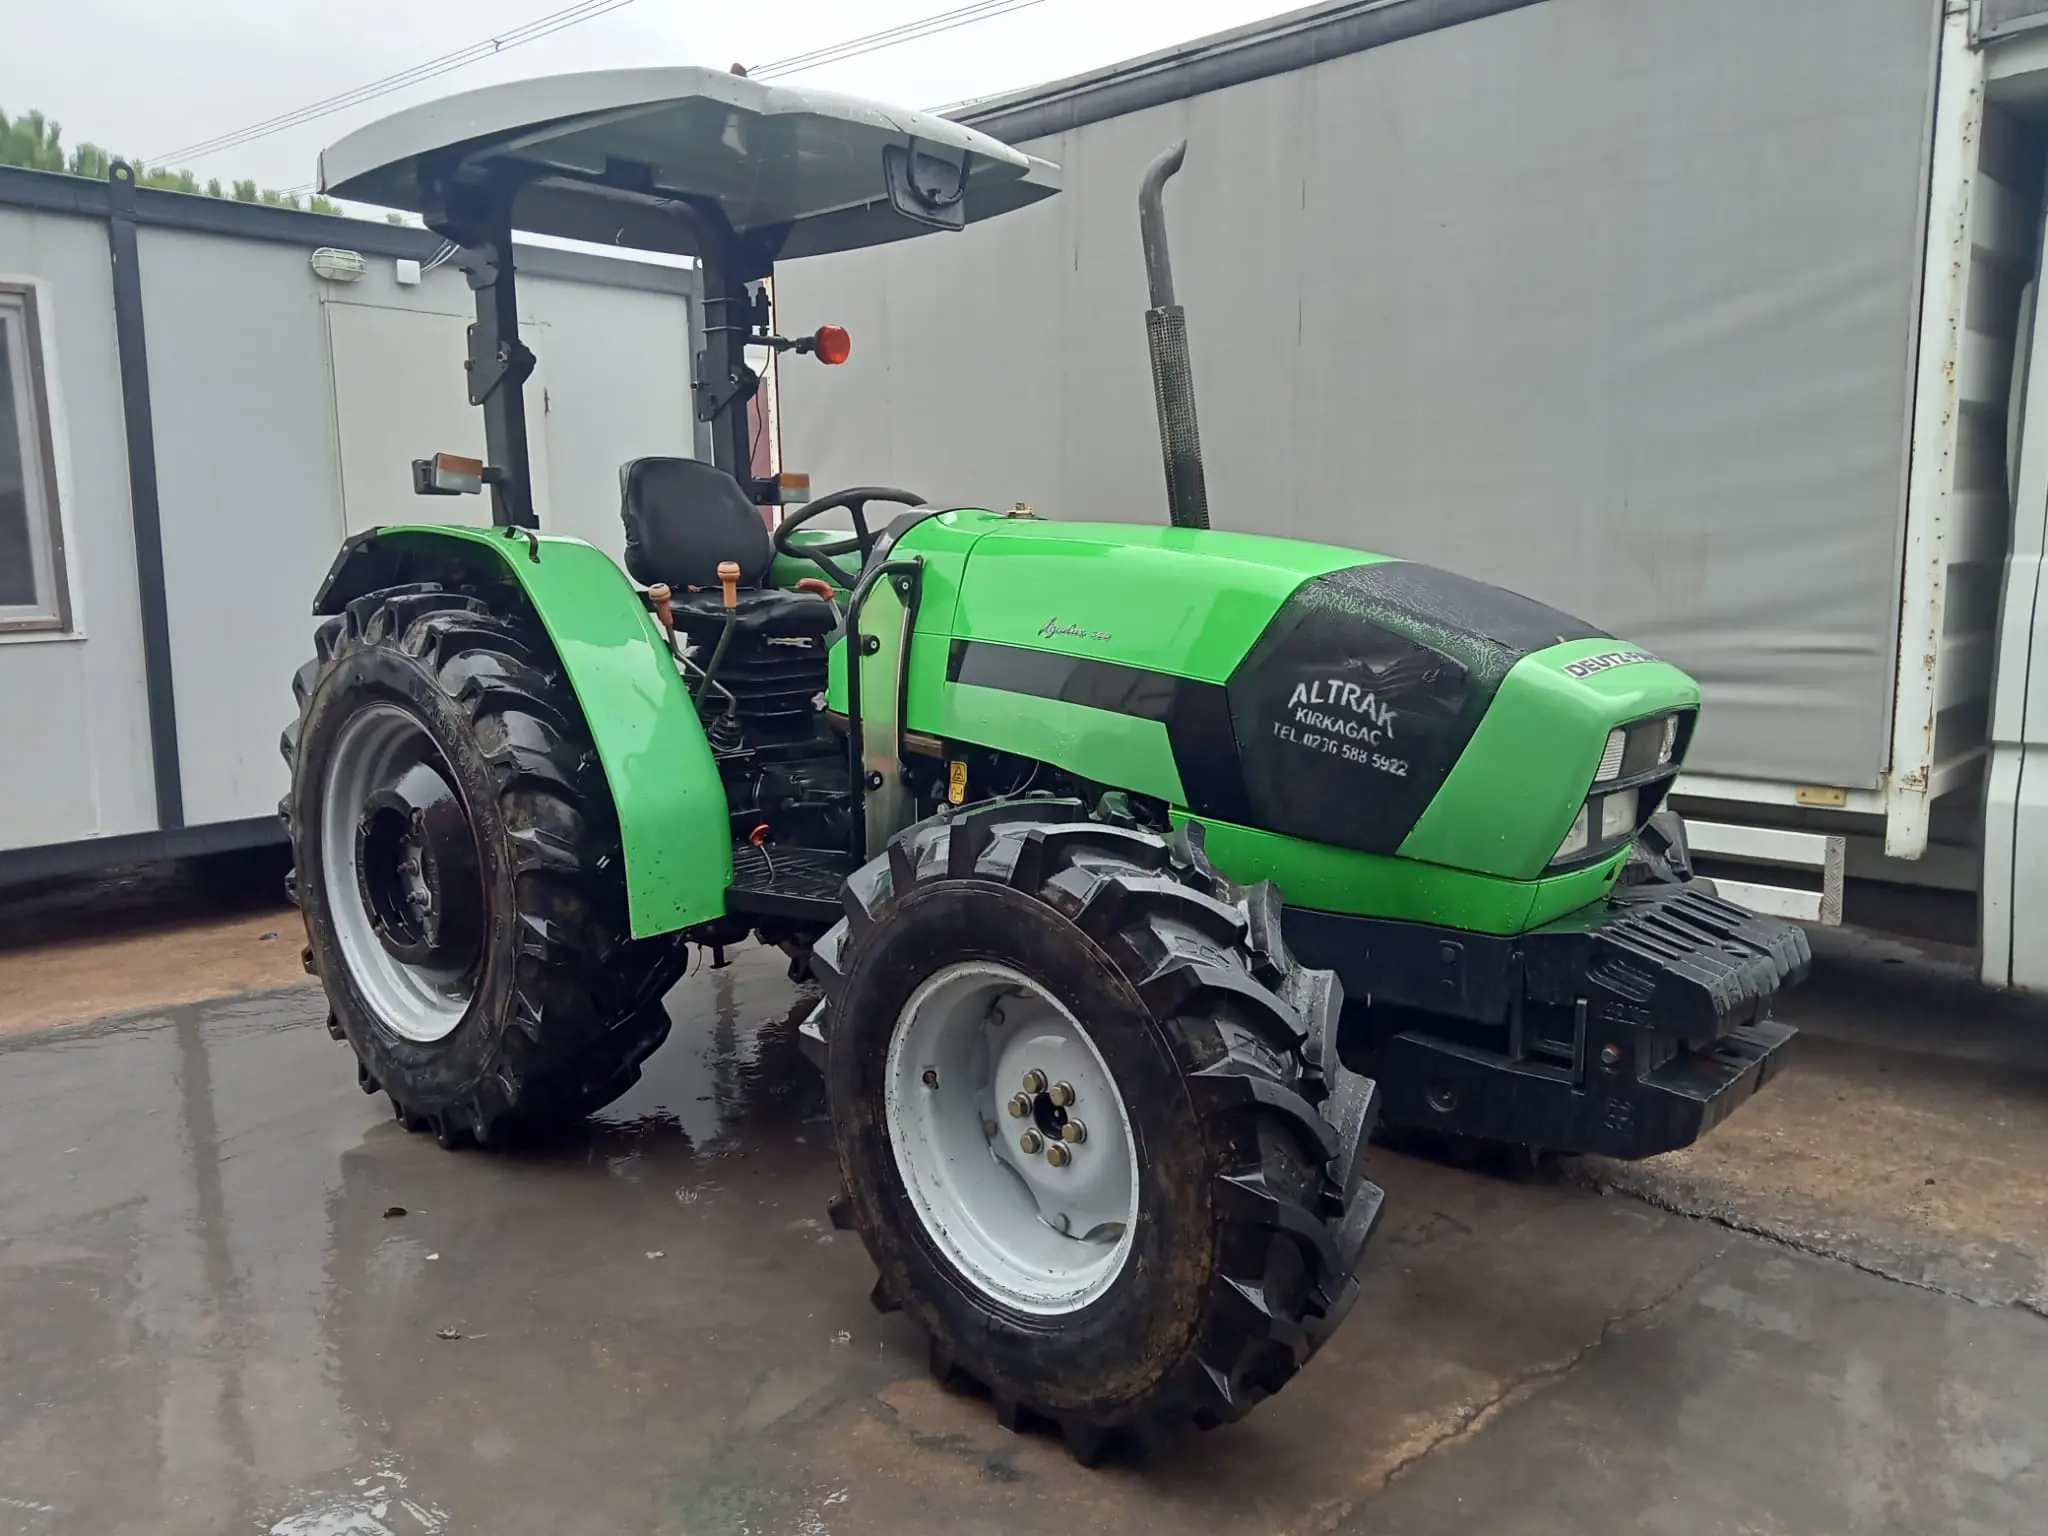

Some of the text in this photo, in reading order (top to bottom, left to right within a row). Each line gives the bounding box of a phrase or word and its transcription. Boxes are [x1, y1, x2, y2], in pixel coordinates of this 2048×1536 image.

[1287, 679, 1399, 740] ALTRAK
[1341, 744, 1368, 764] 588
[1371, 753, 1409, 777] 5922
